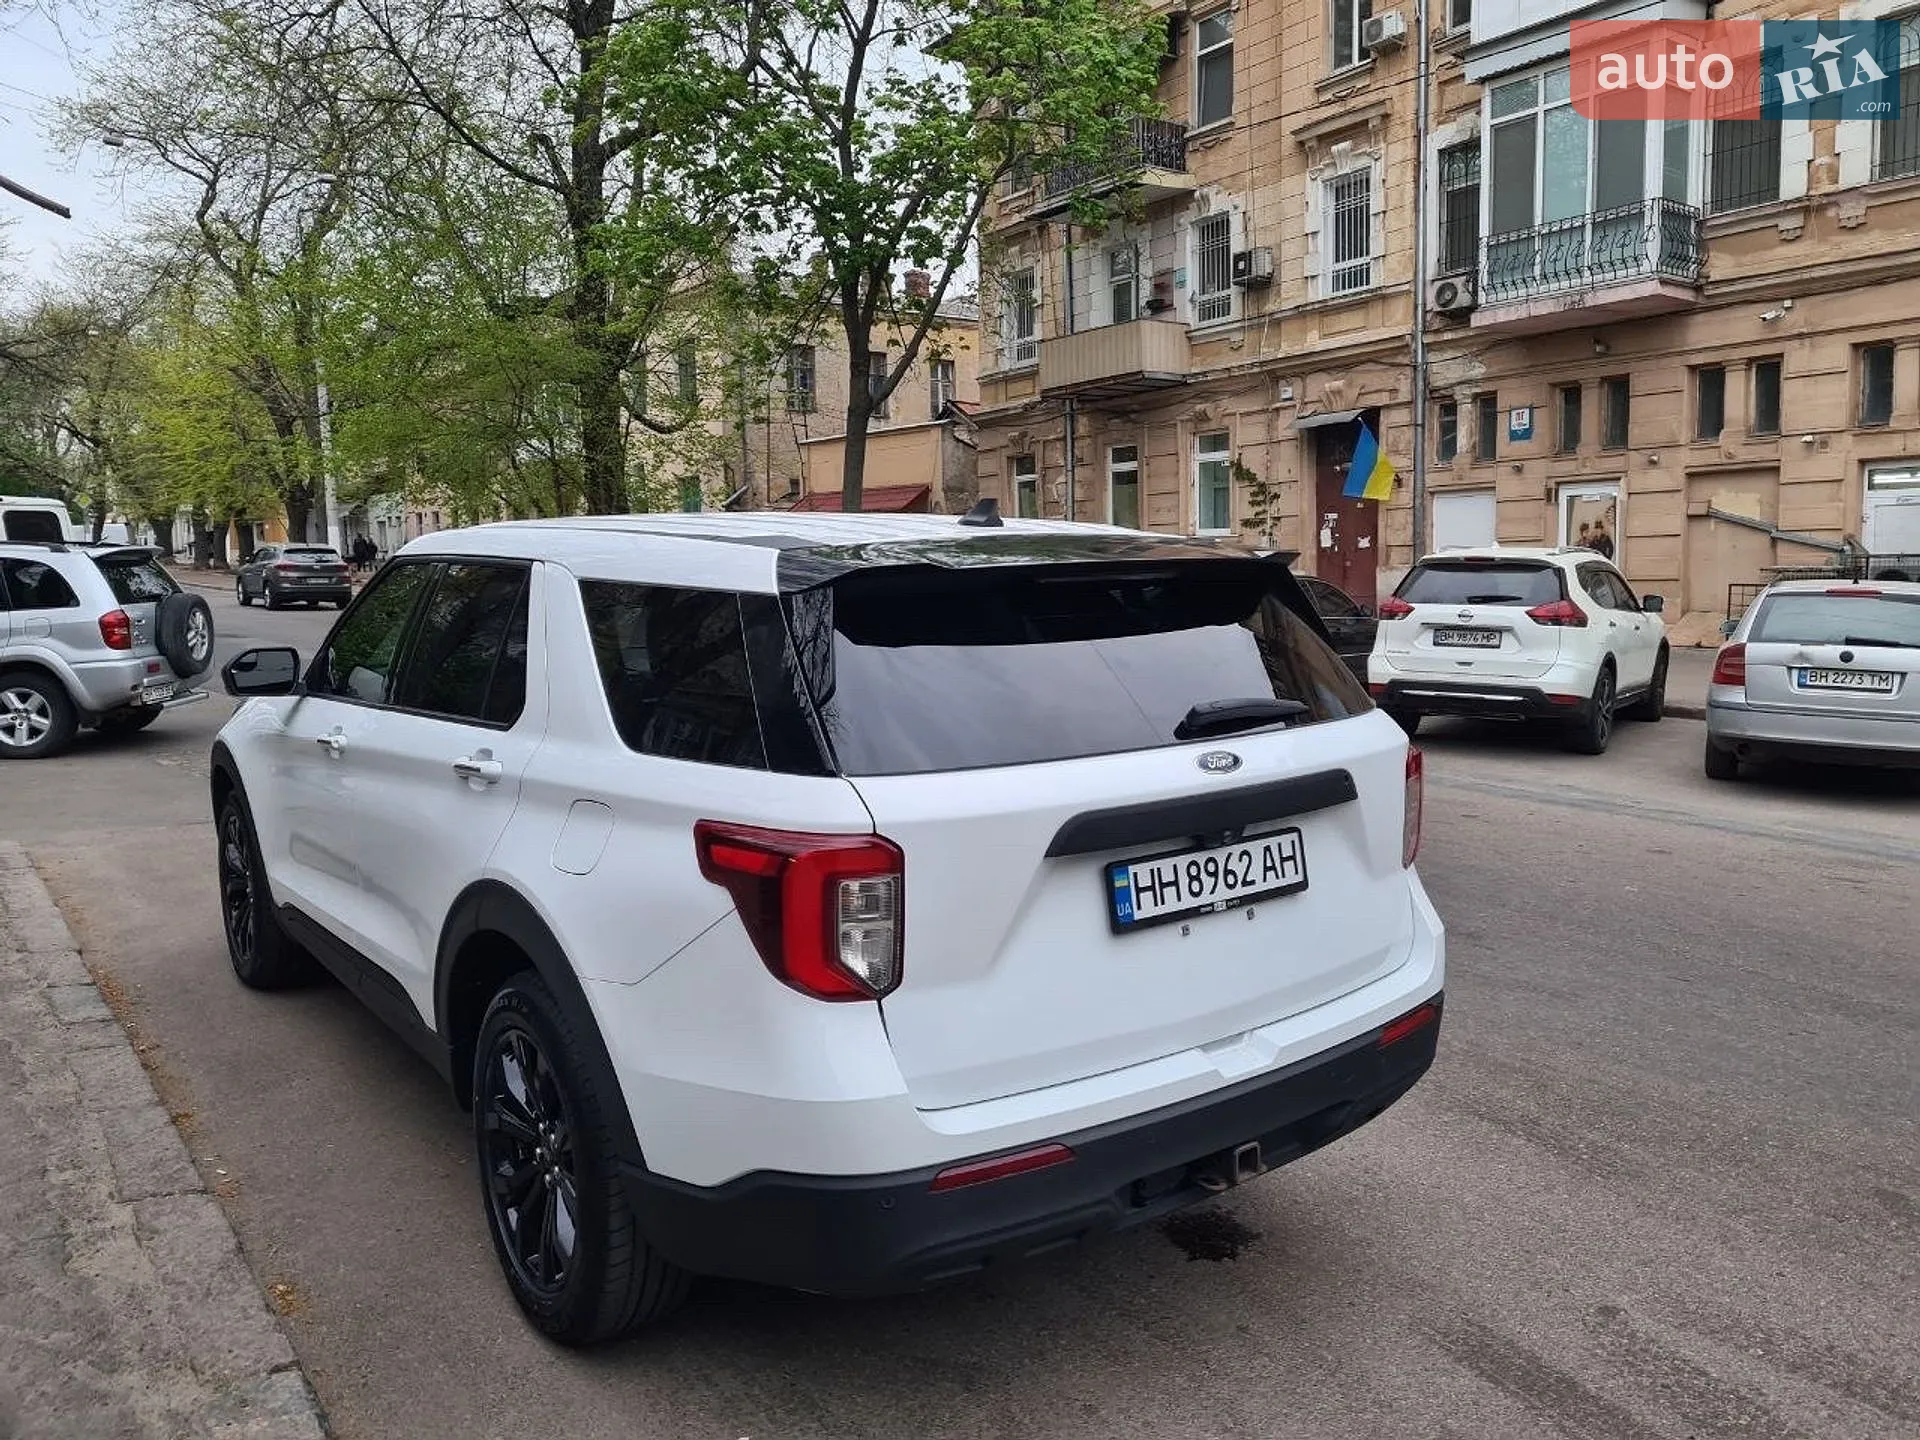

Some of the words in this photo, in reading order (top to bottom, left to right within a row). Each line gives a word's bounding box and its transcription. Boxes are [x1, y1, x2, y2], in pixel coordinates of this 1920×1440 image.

[1808, 670, 1829, 684] BH
[1832, 671, 1865, 686] 2273
[1868, 673, 1890, 687] TM
[1132, 862, 1182, 911] HH
[1186, 849, 1257, 898] 8962
[1262, 839, 1300, 883] AH
[1117, 902, 1132, 917] UA
